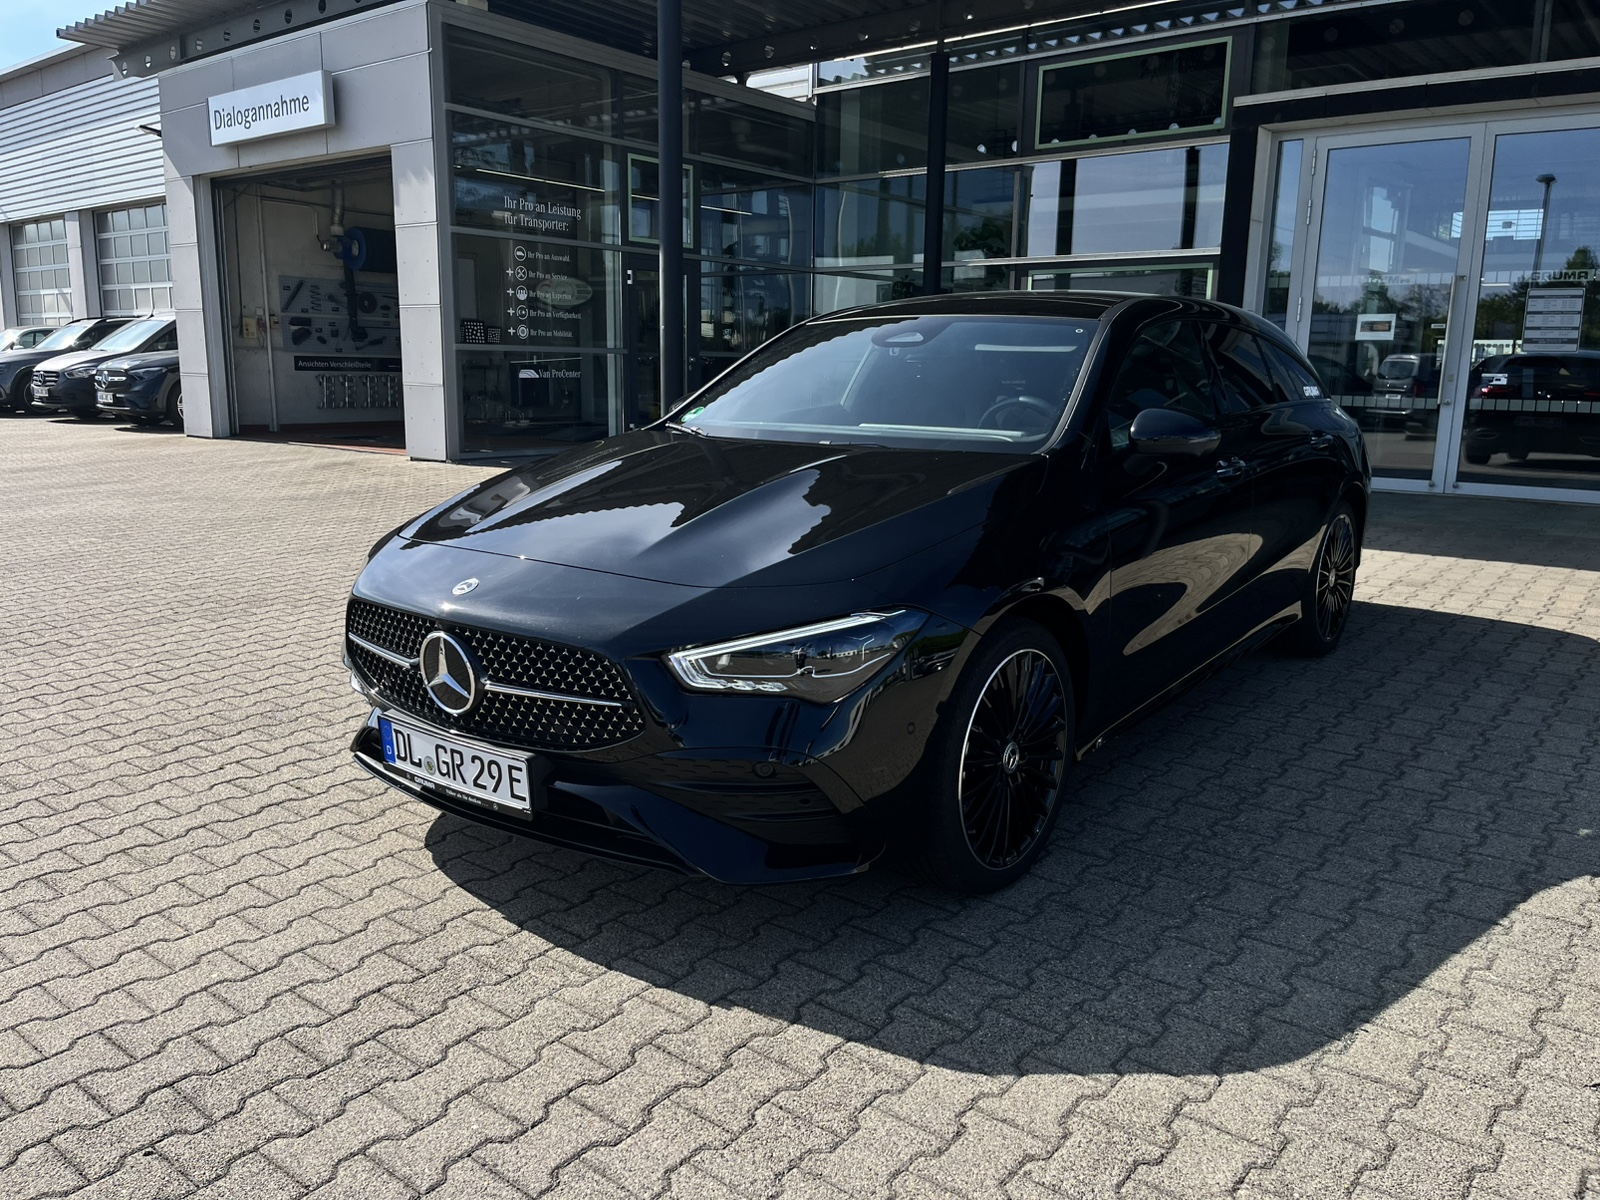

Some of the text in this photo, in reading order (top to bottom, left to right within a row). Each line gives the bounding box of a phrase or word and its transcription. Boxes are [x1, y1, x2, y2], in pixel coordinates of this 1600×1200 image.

[213, 94, 310, 131] Dialogannahme
[504, 196, 582, 220] Ihr Pro an Leistung
[519, 213, 569, 231] Transporter:
[527, 251, 535, 259] Ihr
[535, 251, 544, 260] Pro
[528, 270, 536, 278] Ihr
[536, 271, 545, 280] Pro
[529, 309, 537, 317] Ihr
[537, 310, 546, 318] Pro
[537, 329, 546, 337] Pro
[298, 360, 329, 369] Ansichten
[538, 369, 581, 379] Van ProCenter
[394, 728, 422, 768] DL
[435, 744, 467, 784] GR
